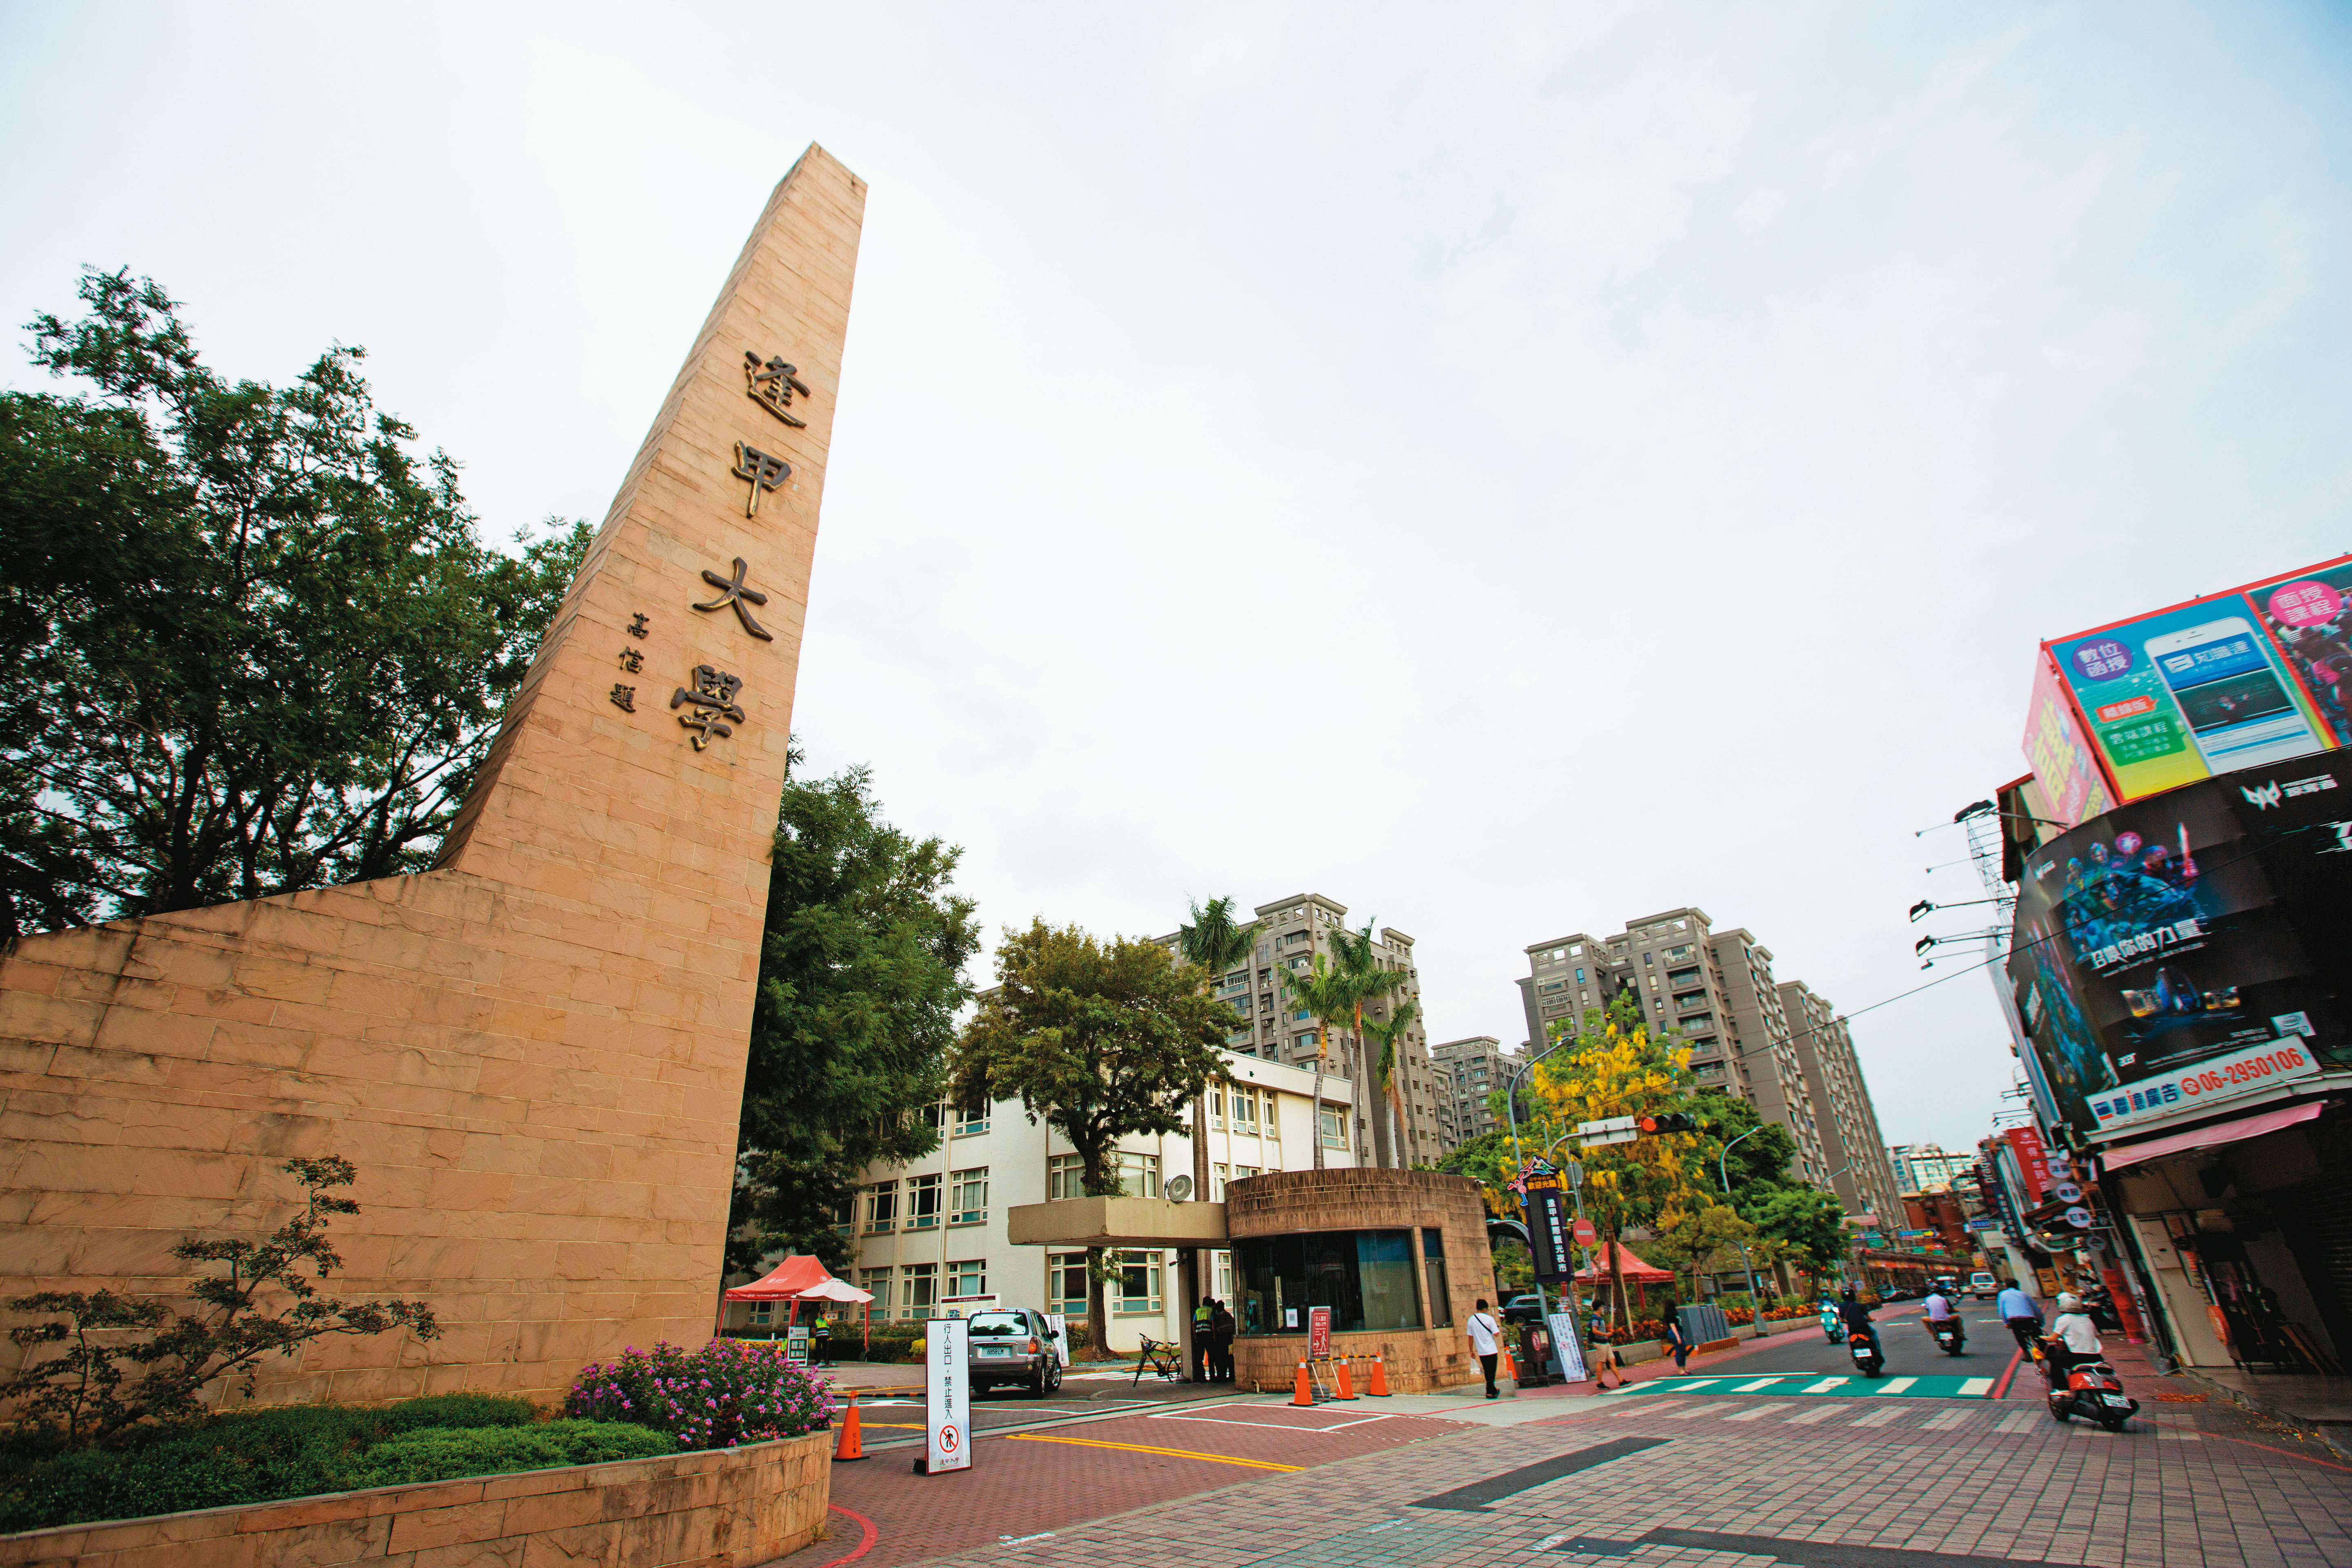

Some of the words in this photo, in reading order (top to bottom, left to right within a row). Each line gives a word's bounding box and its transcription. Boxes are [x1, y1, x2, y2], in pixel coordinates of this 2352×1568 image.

[671, 350, 811, 751] 逢甲大學
[2273, 585, 2326, 609] 面授
[2283, 599, 2336, 623] 課程
[2078, 644, 2122, 664] 數位
[2085, 655, 2129, 677] 函授
[2089, 915, 2212, 971] 召喚你的力量
[2199, 1047, 2305, 1091] 06-2950106
[1528, 1180, 1557, 1189] 歡迎光臨
[1546, 1198, 1567, 1272] 逢甲國際觀光夜市
